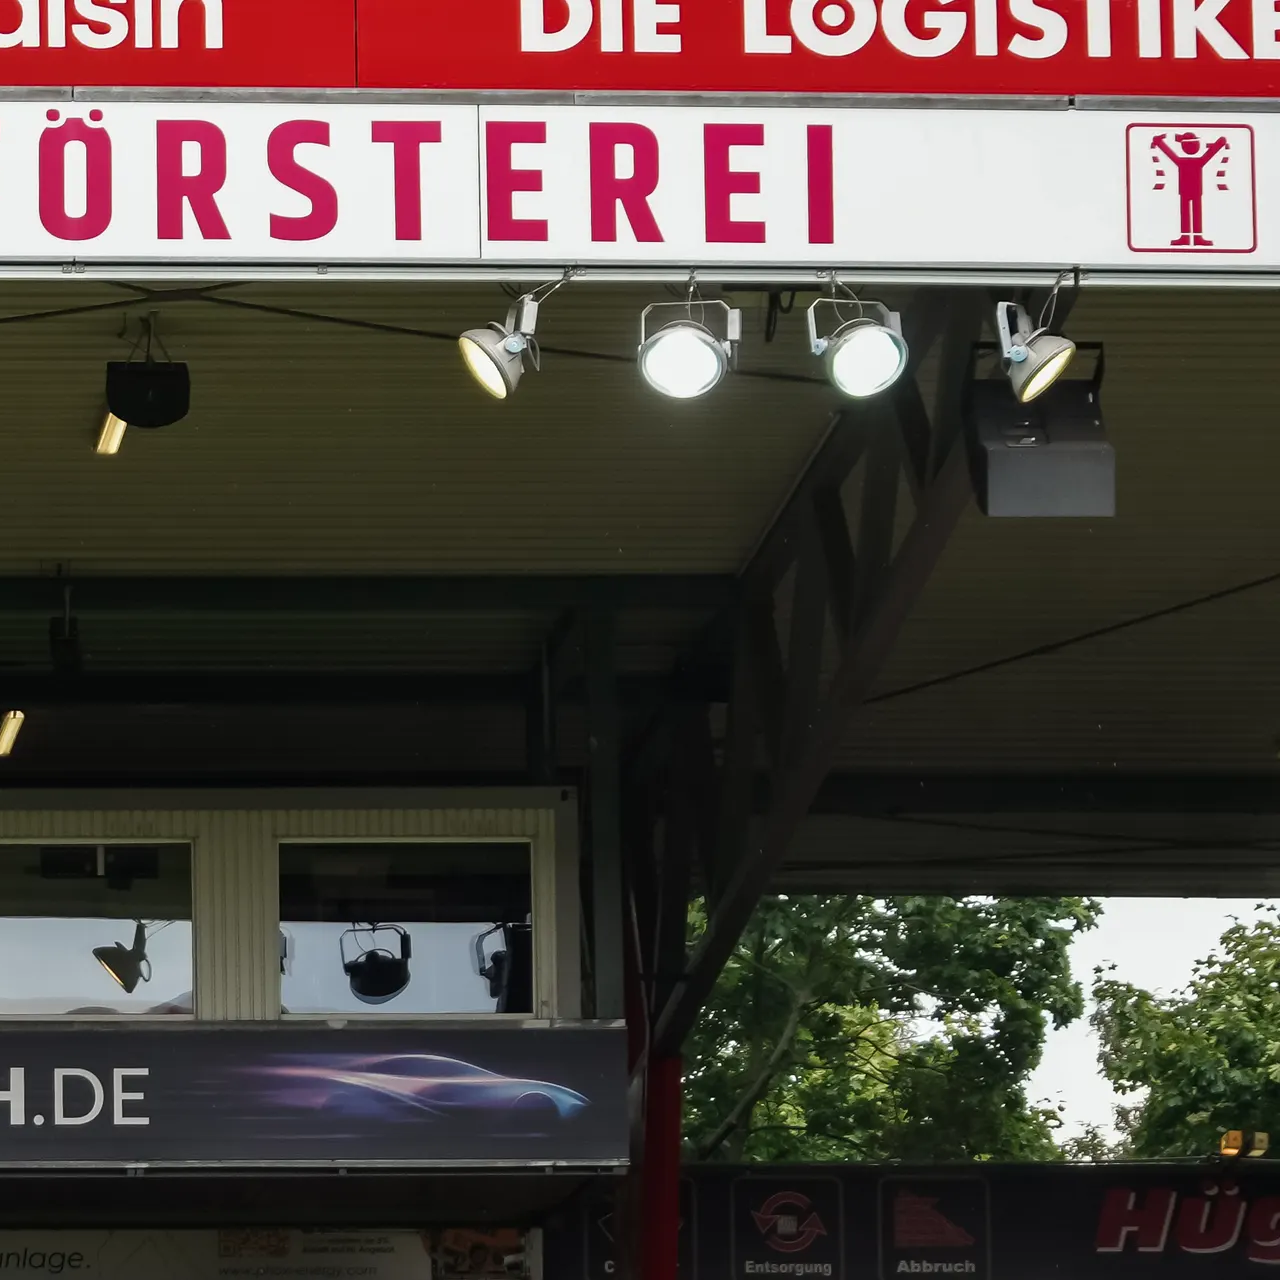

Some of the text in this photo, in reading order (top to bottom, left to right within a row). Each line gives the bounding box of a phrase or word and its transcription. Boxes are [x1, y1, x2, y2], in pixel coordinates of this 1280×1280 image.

[521, 0, 682, 53] DIE
[745, 1260, 833, 1277] Entsorgung
[896, 1259, 976, 1274] Abbruch
